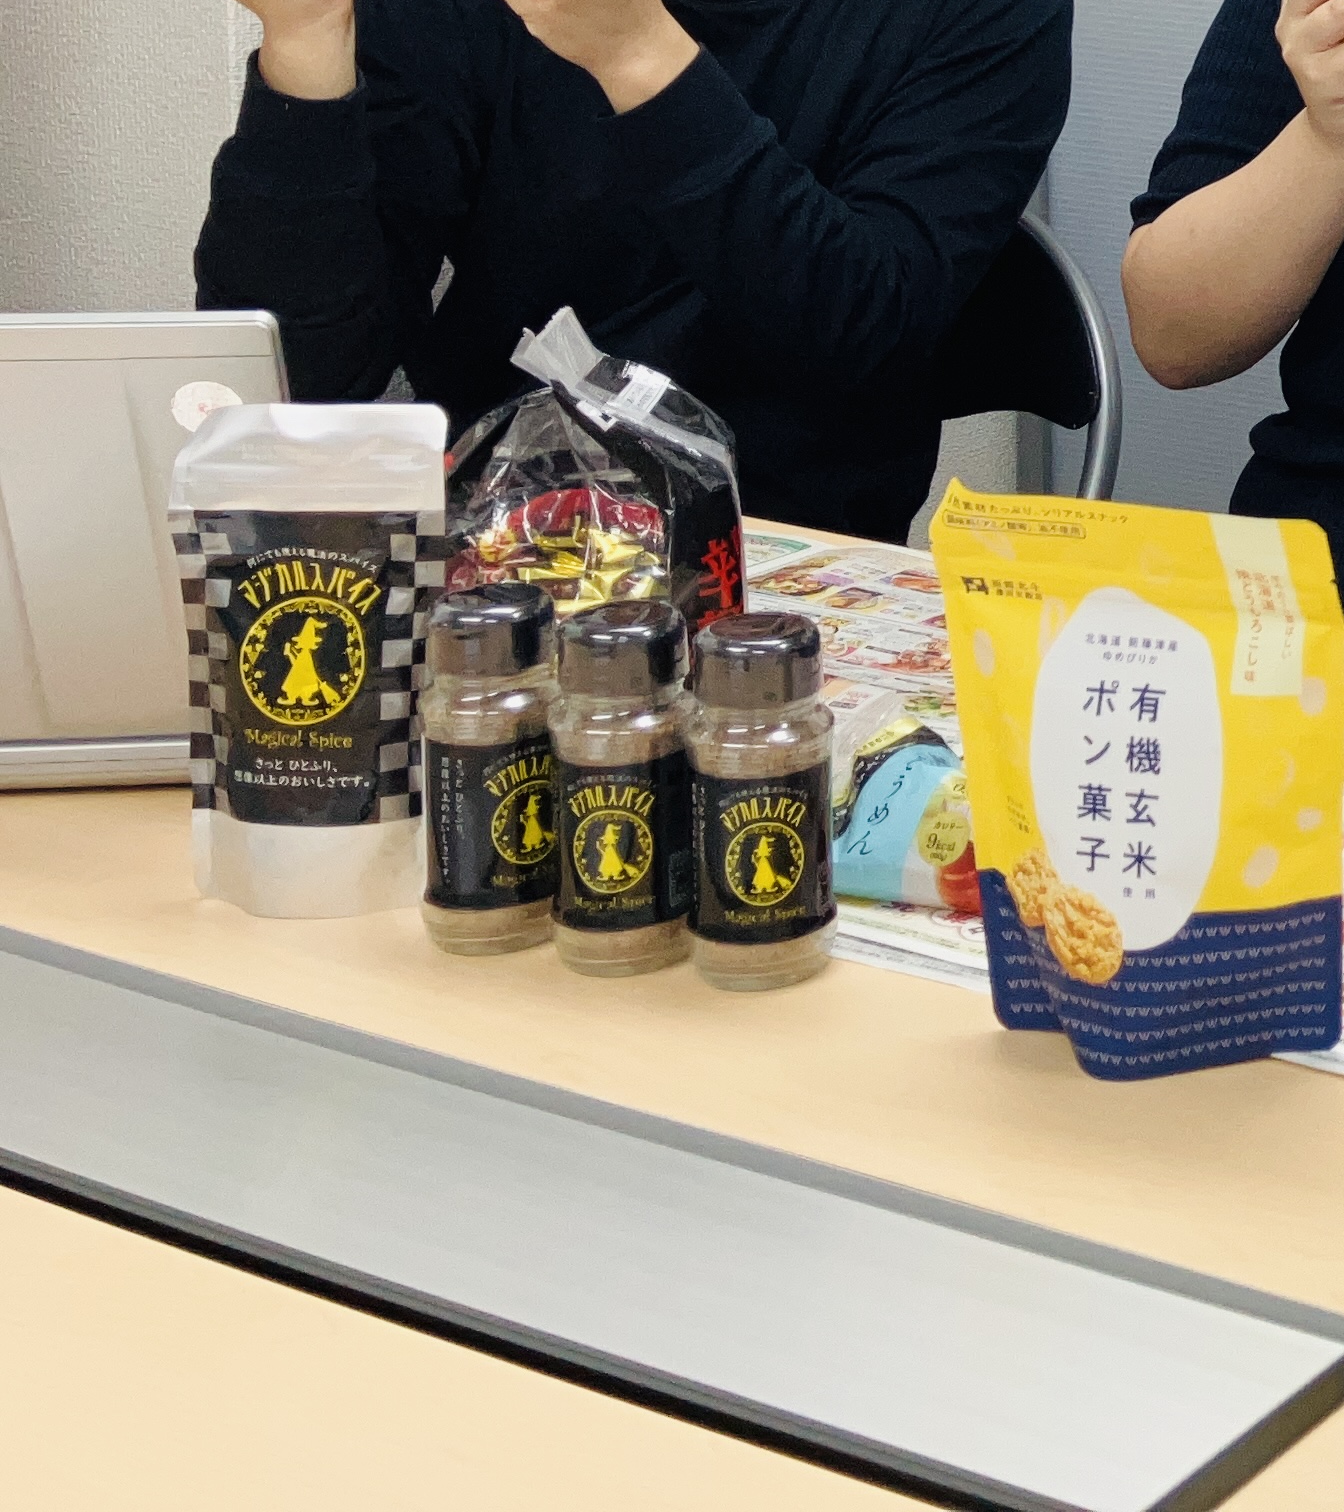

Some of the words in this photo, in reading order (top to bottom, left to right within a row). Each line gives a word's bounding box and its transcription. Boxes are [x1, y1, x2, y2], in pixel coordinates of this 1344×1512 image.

[237, 560, 382, 616] マジカルスパイス
[1075, 681, 1119, 873] ポン菓子
[1121, 683, 1166, 879] 有機玄米
